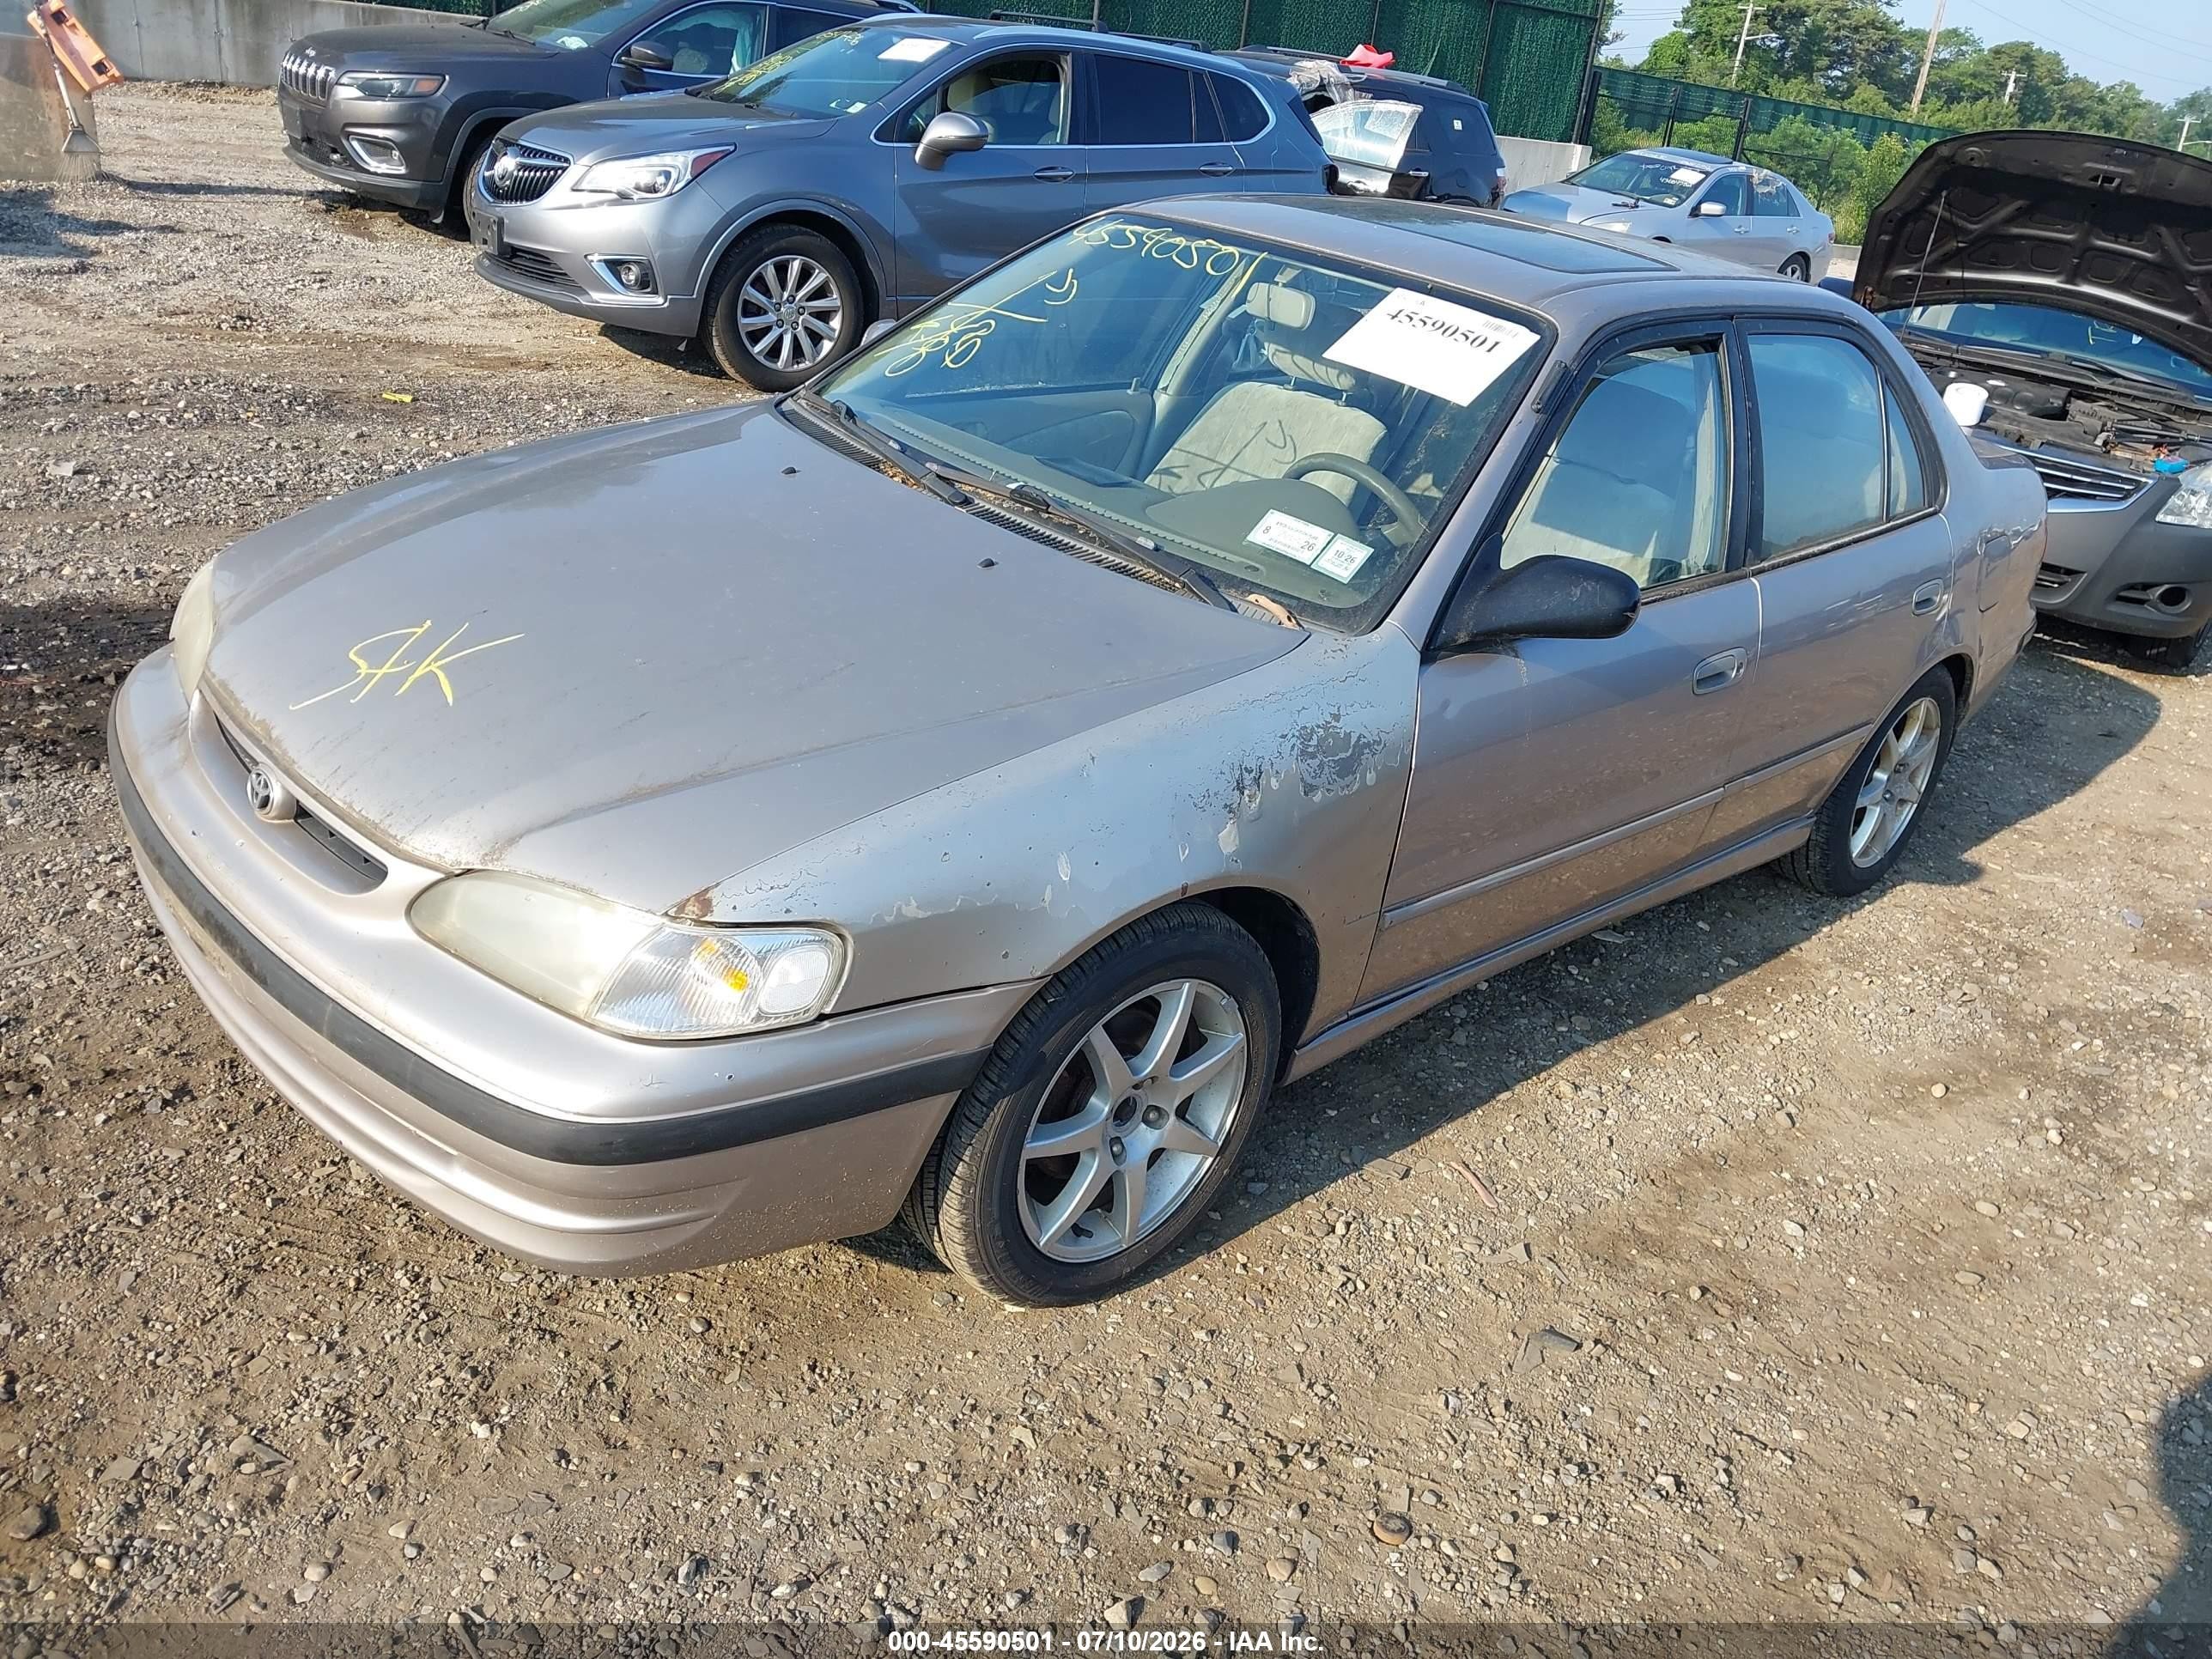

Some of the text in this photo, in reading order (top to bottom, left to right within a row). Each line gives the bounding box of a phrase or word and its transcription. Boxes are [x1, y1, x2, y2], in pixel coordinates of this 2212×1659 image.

[1067, 216, 1269, 299] 45590501
[1387, 307, 1503, 353] 45590501
[1262, 526, 1272, 534] 8
[1300, 540, 1316, 552] 26
[1345, 555, 1358, 563] 26
